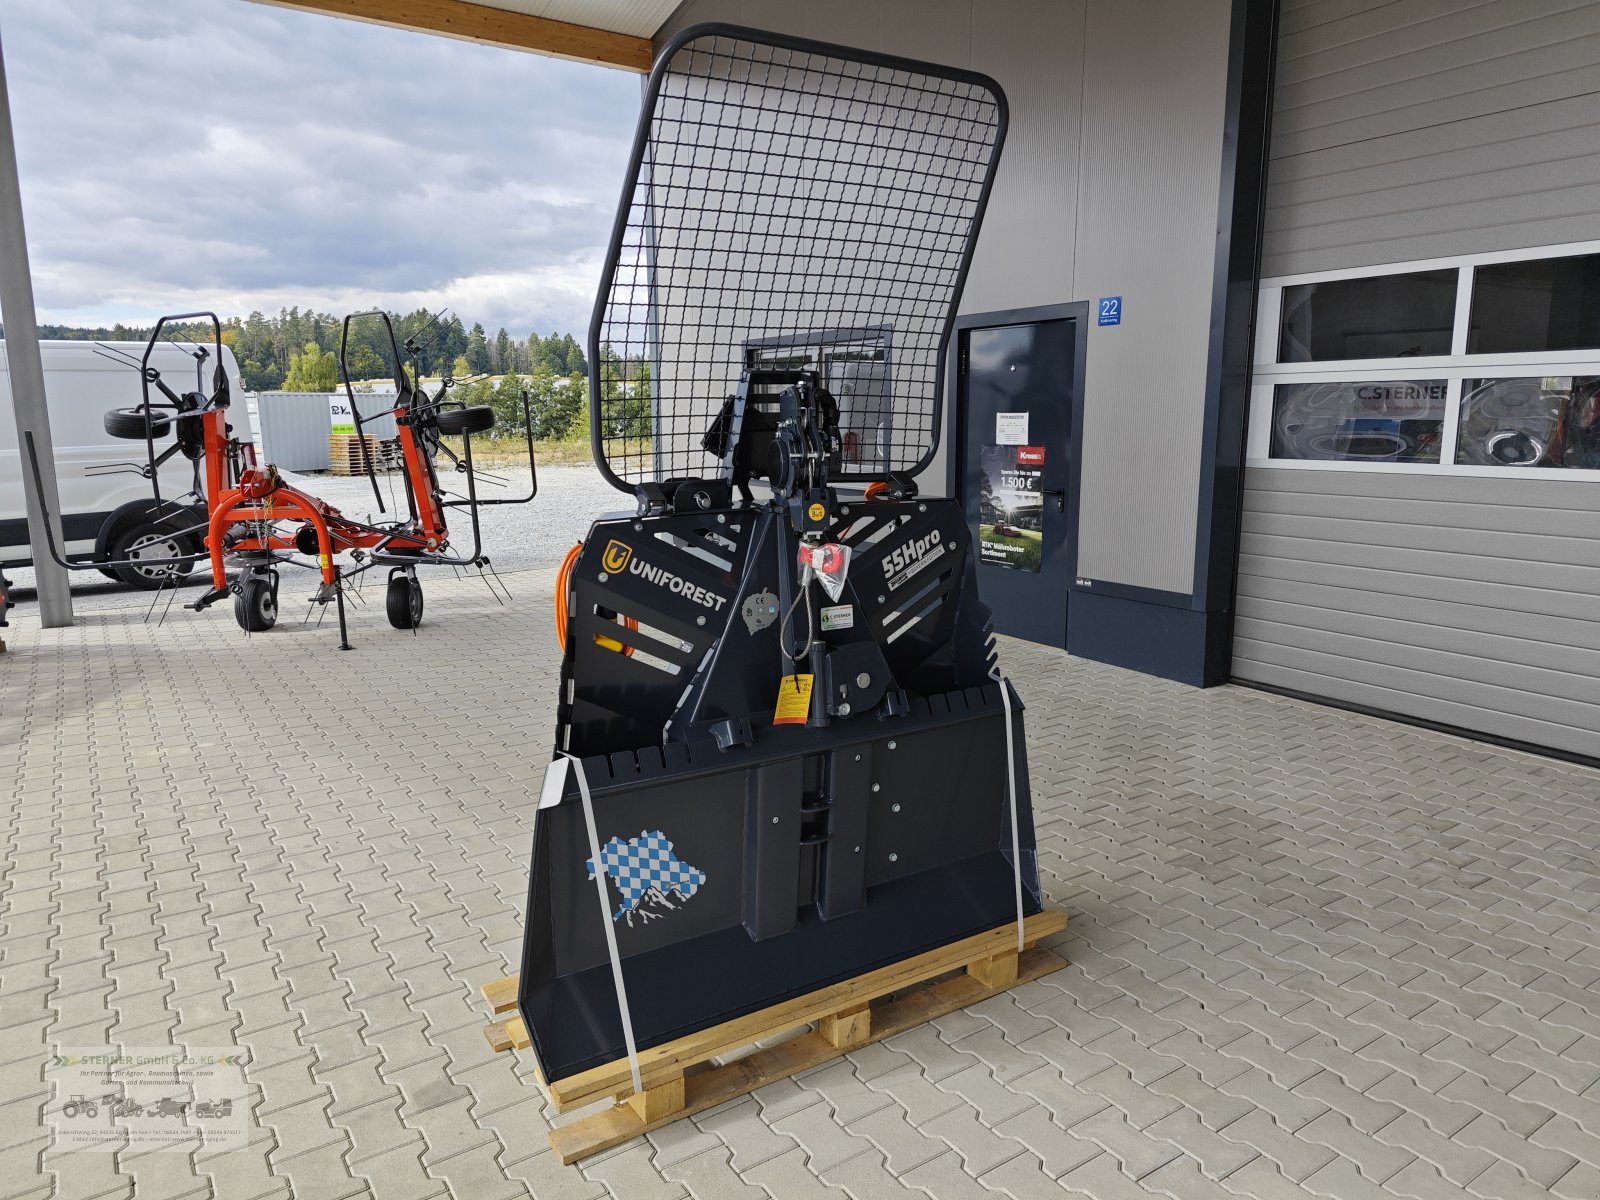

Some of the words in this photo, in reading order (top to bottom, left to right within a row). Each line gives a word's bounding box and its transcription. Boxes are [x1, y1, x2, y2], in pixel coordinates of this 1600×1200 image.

[1102, 300, 1118, 316] 22
[1001, 476, 1025, 488] 1.500
[1026, 478, 1032, 489] €
[882, 530, 940, 578] 55Hpro
[630, 557, 727, 611] UNIFOREST
